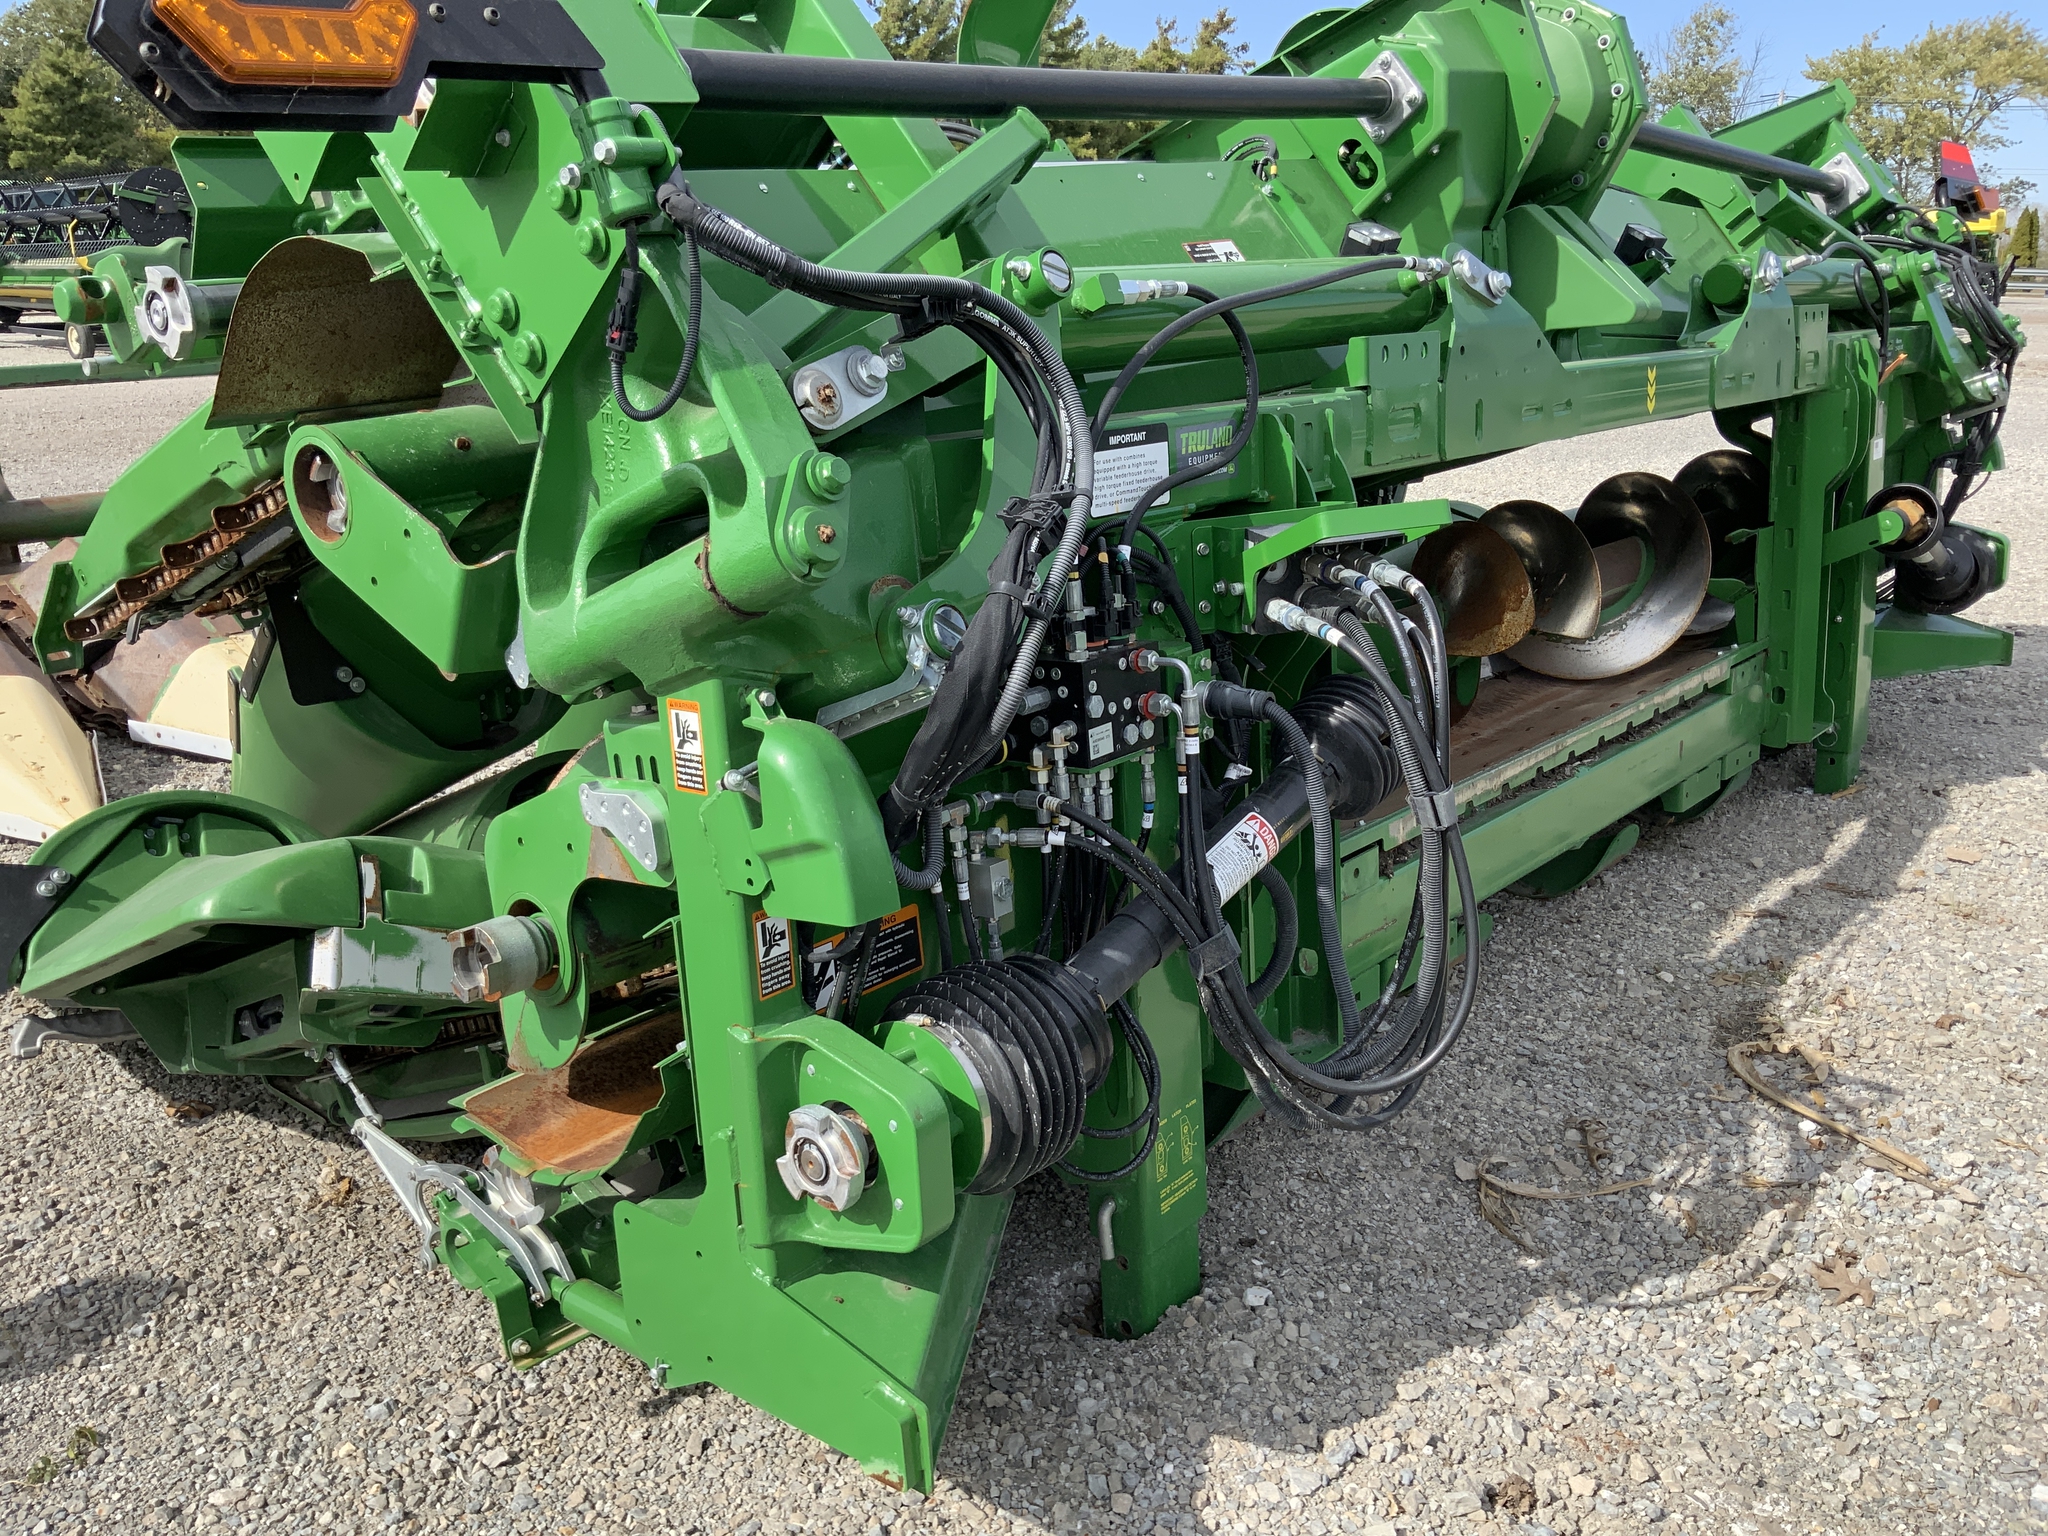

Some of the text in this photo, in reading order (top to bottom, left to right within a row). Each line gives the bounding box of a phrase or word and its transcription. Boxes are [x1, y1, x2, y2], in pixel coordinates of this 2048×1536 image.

[1108, 432, 1146, 446] IMPORTANT
[1180, 425, 1232, 454] TRULAND
[1124, 452, 1146, 461] combines
[1106, 482, 1122, 490] torque
